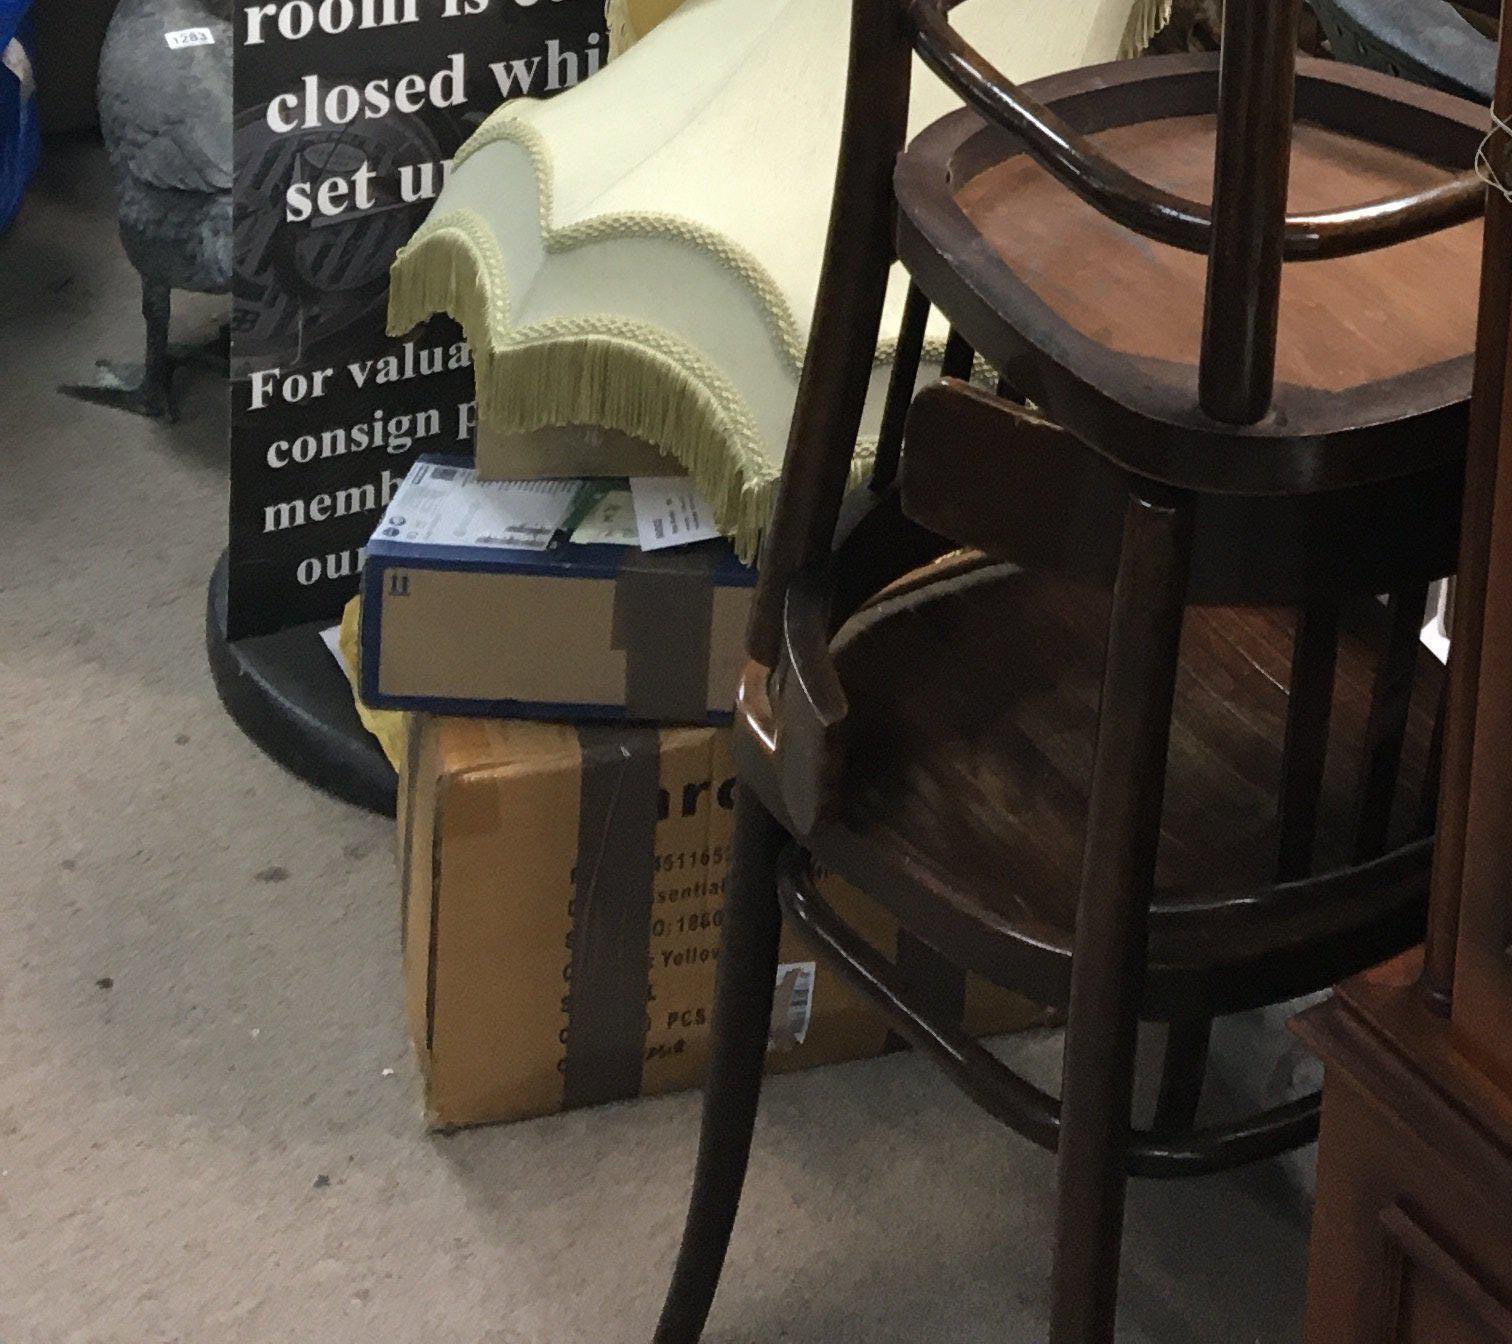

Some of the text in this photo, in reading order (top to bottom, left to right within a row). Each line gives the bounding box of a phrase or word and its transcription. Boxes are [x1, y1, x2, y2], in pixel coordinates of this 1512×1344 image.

[265, 52, 469, 134] closed
[285, 158, 377, 224] set
[247, 366, 334, 411] For
[265, 408, 442, 469] consign
